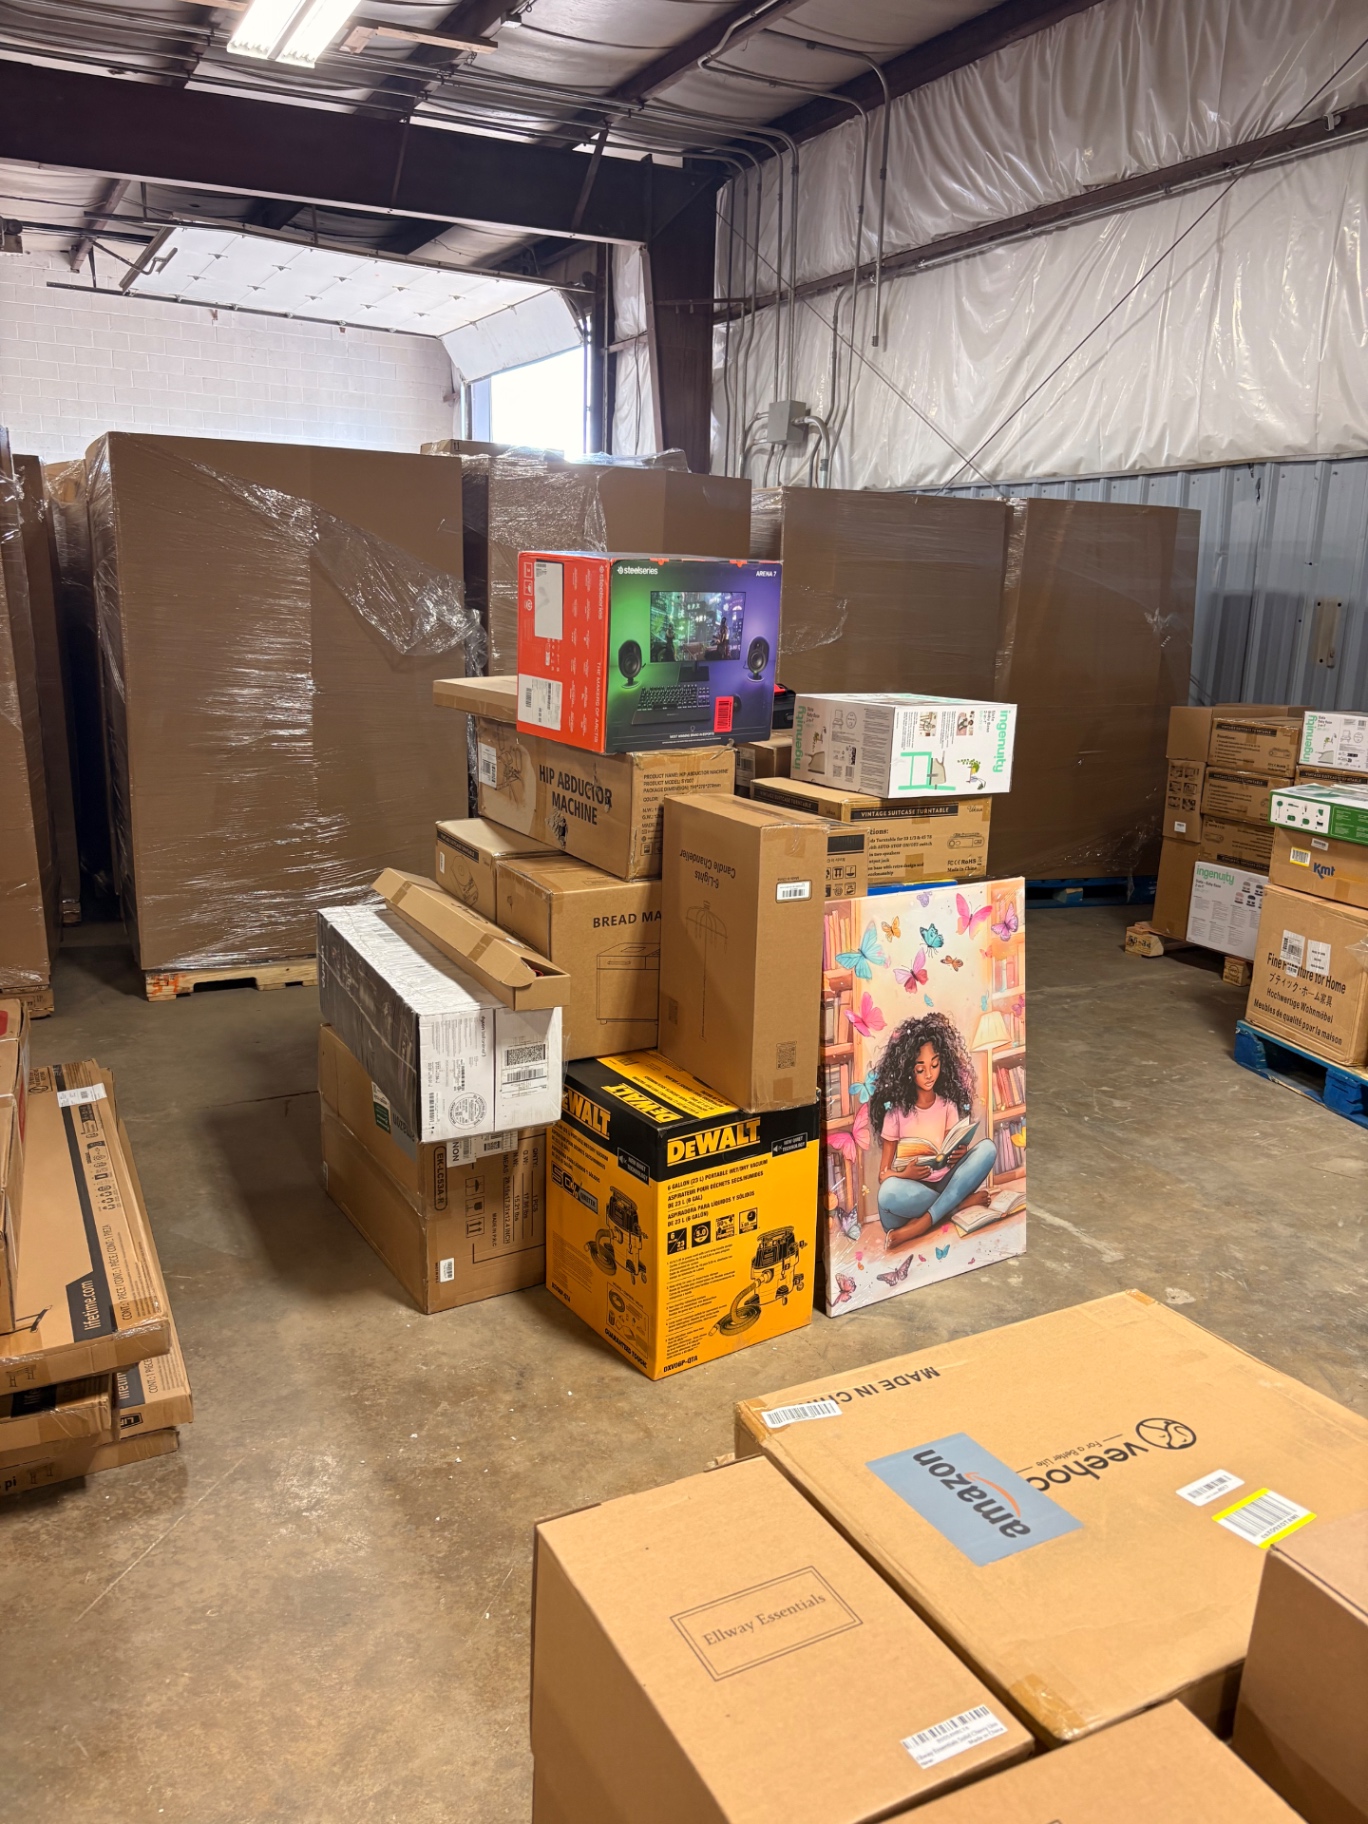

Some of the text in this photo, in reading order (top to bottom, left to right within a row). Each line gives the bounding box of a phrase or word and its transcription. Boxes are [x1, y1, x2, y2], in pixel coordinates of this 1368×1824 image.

[623, 566, 658, 575] steelseries
[793, 706, 806, 769] ingenuity
[992, 709, 1011, 773] ingenuity
[1301, 715, 1318, 762] ingenuity
[539, 764, 612, 808] HIP ABDUCTOR
[552, 791, 598, 826] MACHINE
[916, 807, 949, 815] TURNTABLE
[679, 849, 736, 879] Candle Chandelier
[694, 870, 719, 889] 6-Lights
[1196, 865, 1235, 885] ingenuity
[1313, 862, 1335, 879] Kmt
[593, 910, 662, 928] BREAD MA
[1267, 952, 1281, 970] Fine
[1313, 971, 1325, 984] for
[1325, 975, 1347, 995] Home
[1267, 987, 1333, 1024] Hochwertige Wohnmöbel
[1254, 998, 1276, 1015] Meubles
[1276, 1008, 1282, 1018] de
[1283, 1012, 1302, 1028] qualité
[1302, 1019, 1316, 1034] pour
[1321, 1030, 1343, 1046] maison
[562, 1088, 611, 1137] EWALT
[603, 1085, 678, 1123] DEWALT
[452, 1141, 460, 1162] NON
[437, 1152, 445, 1204] EK-LC53A-R
[668, 1189, 696, 1201] ASPIRATEUR
[697, 1185, 709, 1193] POUR
[672, 1180, 690, 1189] GALLON
[705, 1169, 728, 1180] PORTABLE
[668, 1207, 696, 1219] ASPIRADORA
[697, 1203, 710, 1212] PARA
[81, 1280, 101, 1331] lifetime.com
[853, 1366, 941, 1398] MADE IN
[1035, 1454, 1053, 1467] Life
[1052, 1449, 1079, 1462] Better
[1085, 1440, 1103, 1452] For
[912, 1448, 1031, 1538] amazon
[702, 1593, 827, 1646] Ellway Essentials
